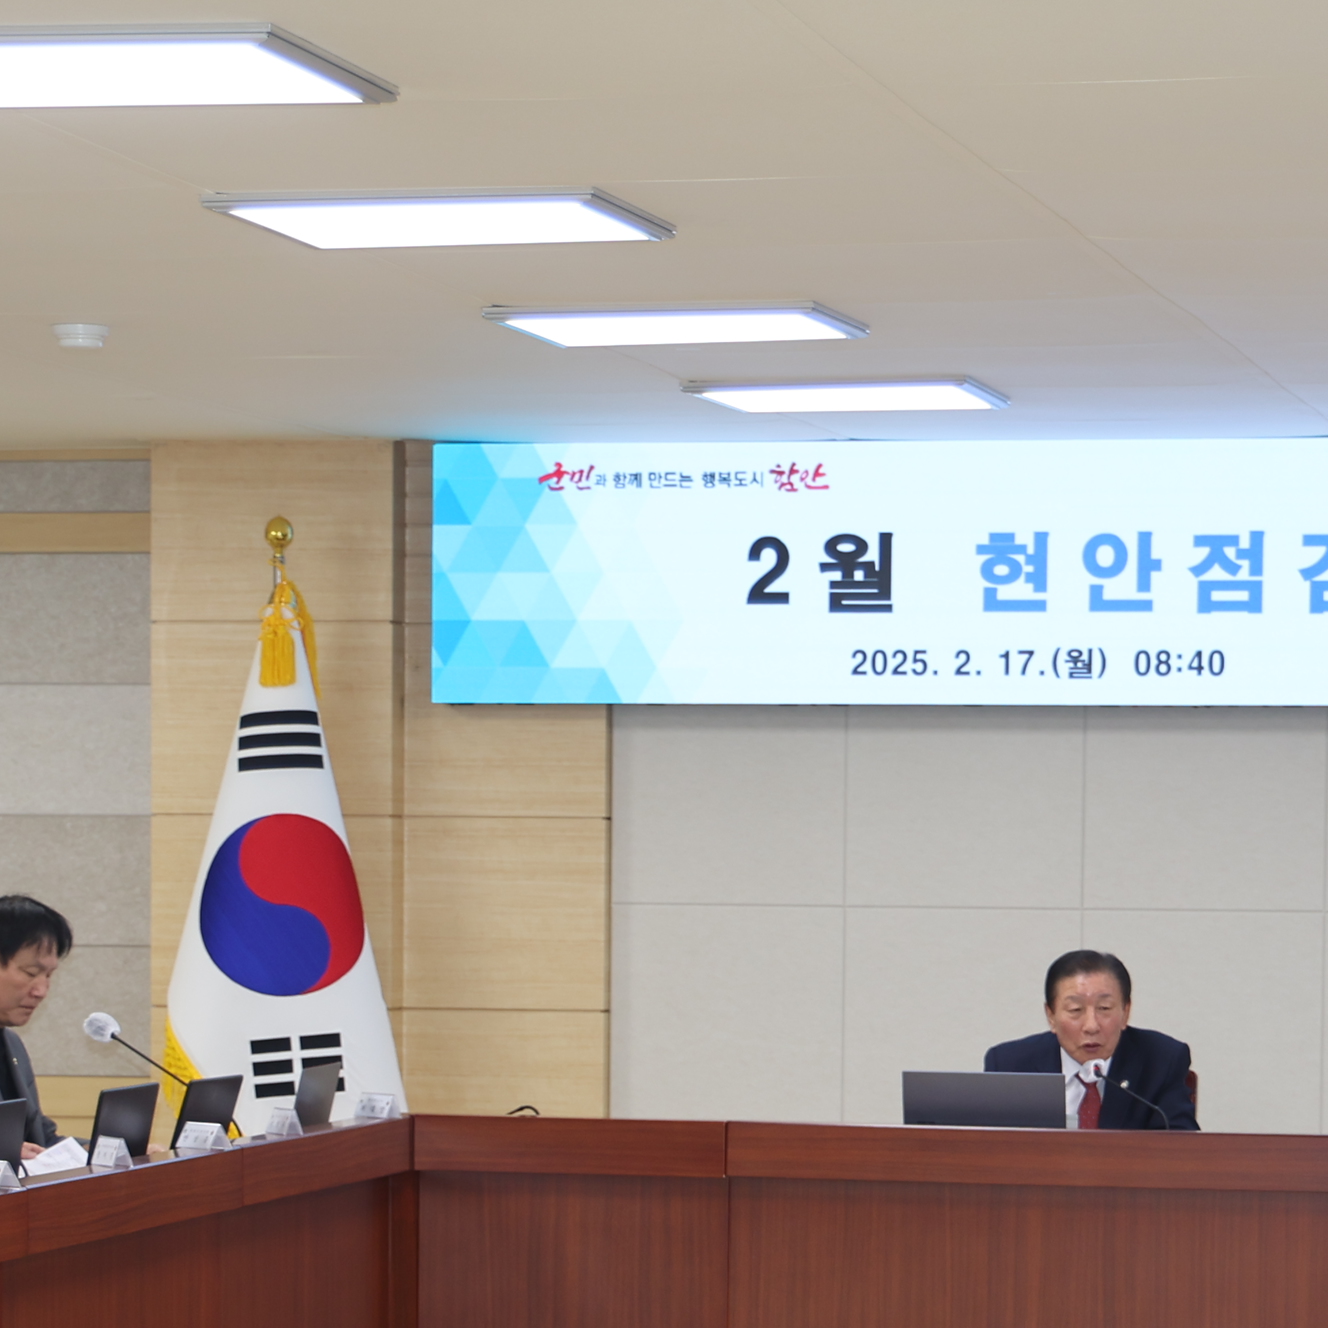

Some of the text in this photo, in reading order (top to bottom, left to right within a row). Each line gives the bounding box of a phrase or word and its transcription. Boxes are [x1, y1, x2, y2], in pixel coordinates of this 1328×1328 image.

[538, 462, 830, 492] 군민과 함께 만드는 행복도시 함안
[746, 532, 894, 614] 2월
[851, 647, 1226, 679] 2025. 2. 17.(월) 08:40
